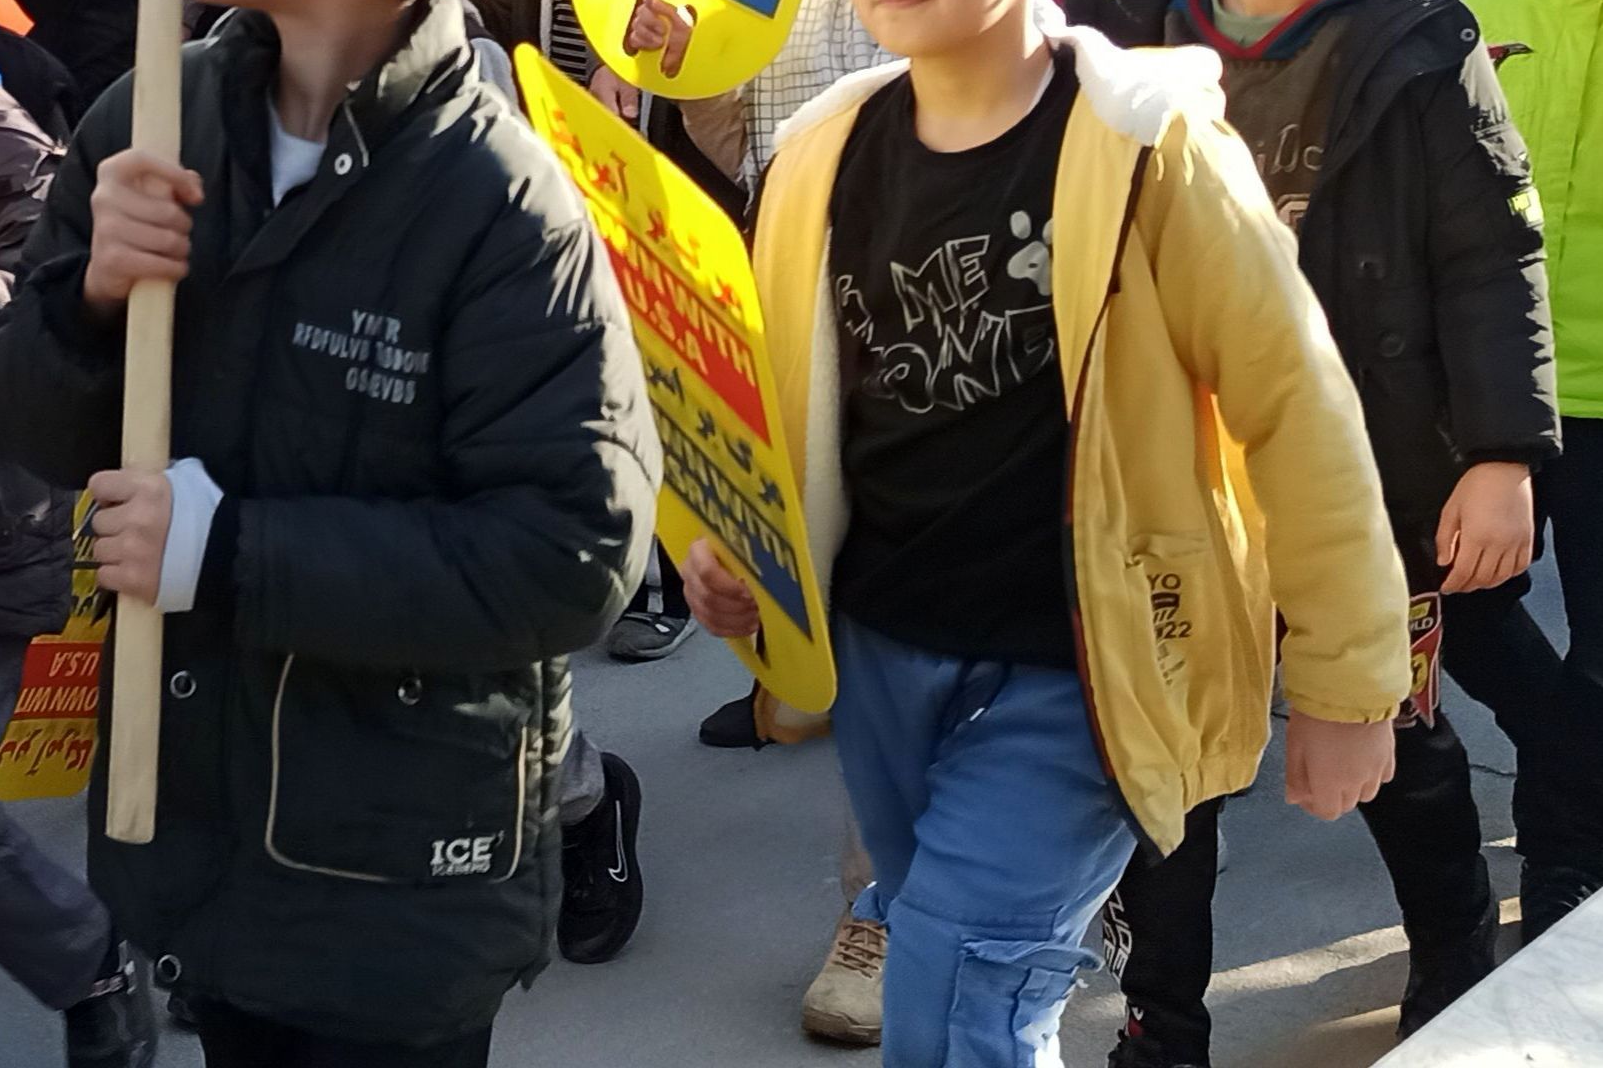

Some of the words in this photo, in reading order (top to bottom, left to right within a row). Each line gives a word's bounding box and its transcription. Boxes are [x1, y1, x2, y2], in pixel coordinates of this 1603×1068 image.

[663, 268, 756, 387] WITH
[665, 455, 763, 578] SRAEL
[709, 466, 799, 582] WITH
[13, 686, 52, 714] WIT
[50, 685, 100, 713] OWN
[430, 835, 497, 866] ICE
